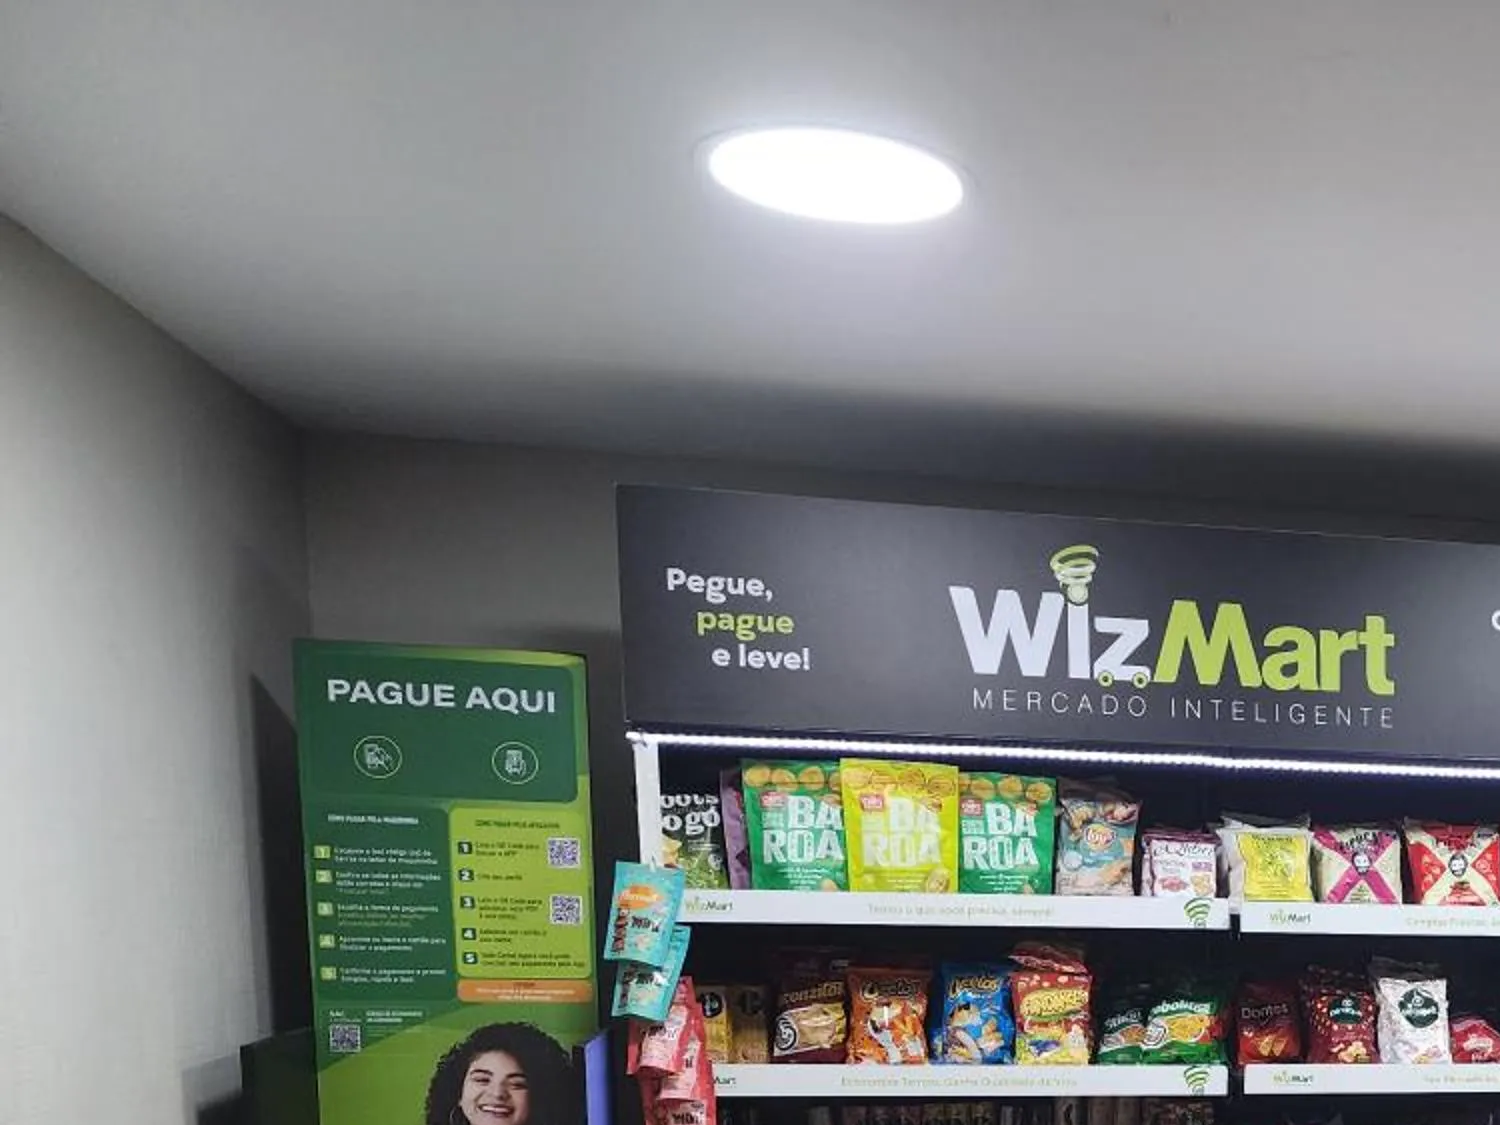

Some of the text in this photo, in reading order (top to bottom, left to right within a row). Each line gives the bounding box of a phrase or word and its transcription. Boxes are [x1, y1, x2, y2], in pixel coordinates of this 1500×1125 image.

[667, 567, 773, 604] Pegue,
[697, 610, 795, 642] pague
[948, 583, 1395, 696] WizMart
[712, 648, 731, 668] e
[327, 679, 556, 715] PAGUE AQUI
[973, 687, 1395, 730] MERCADO INTELIGENTE
